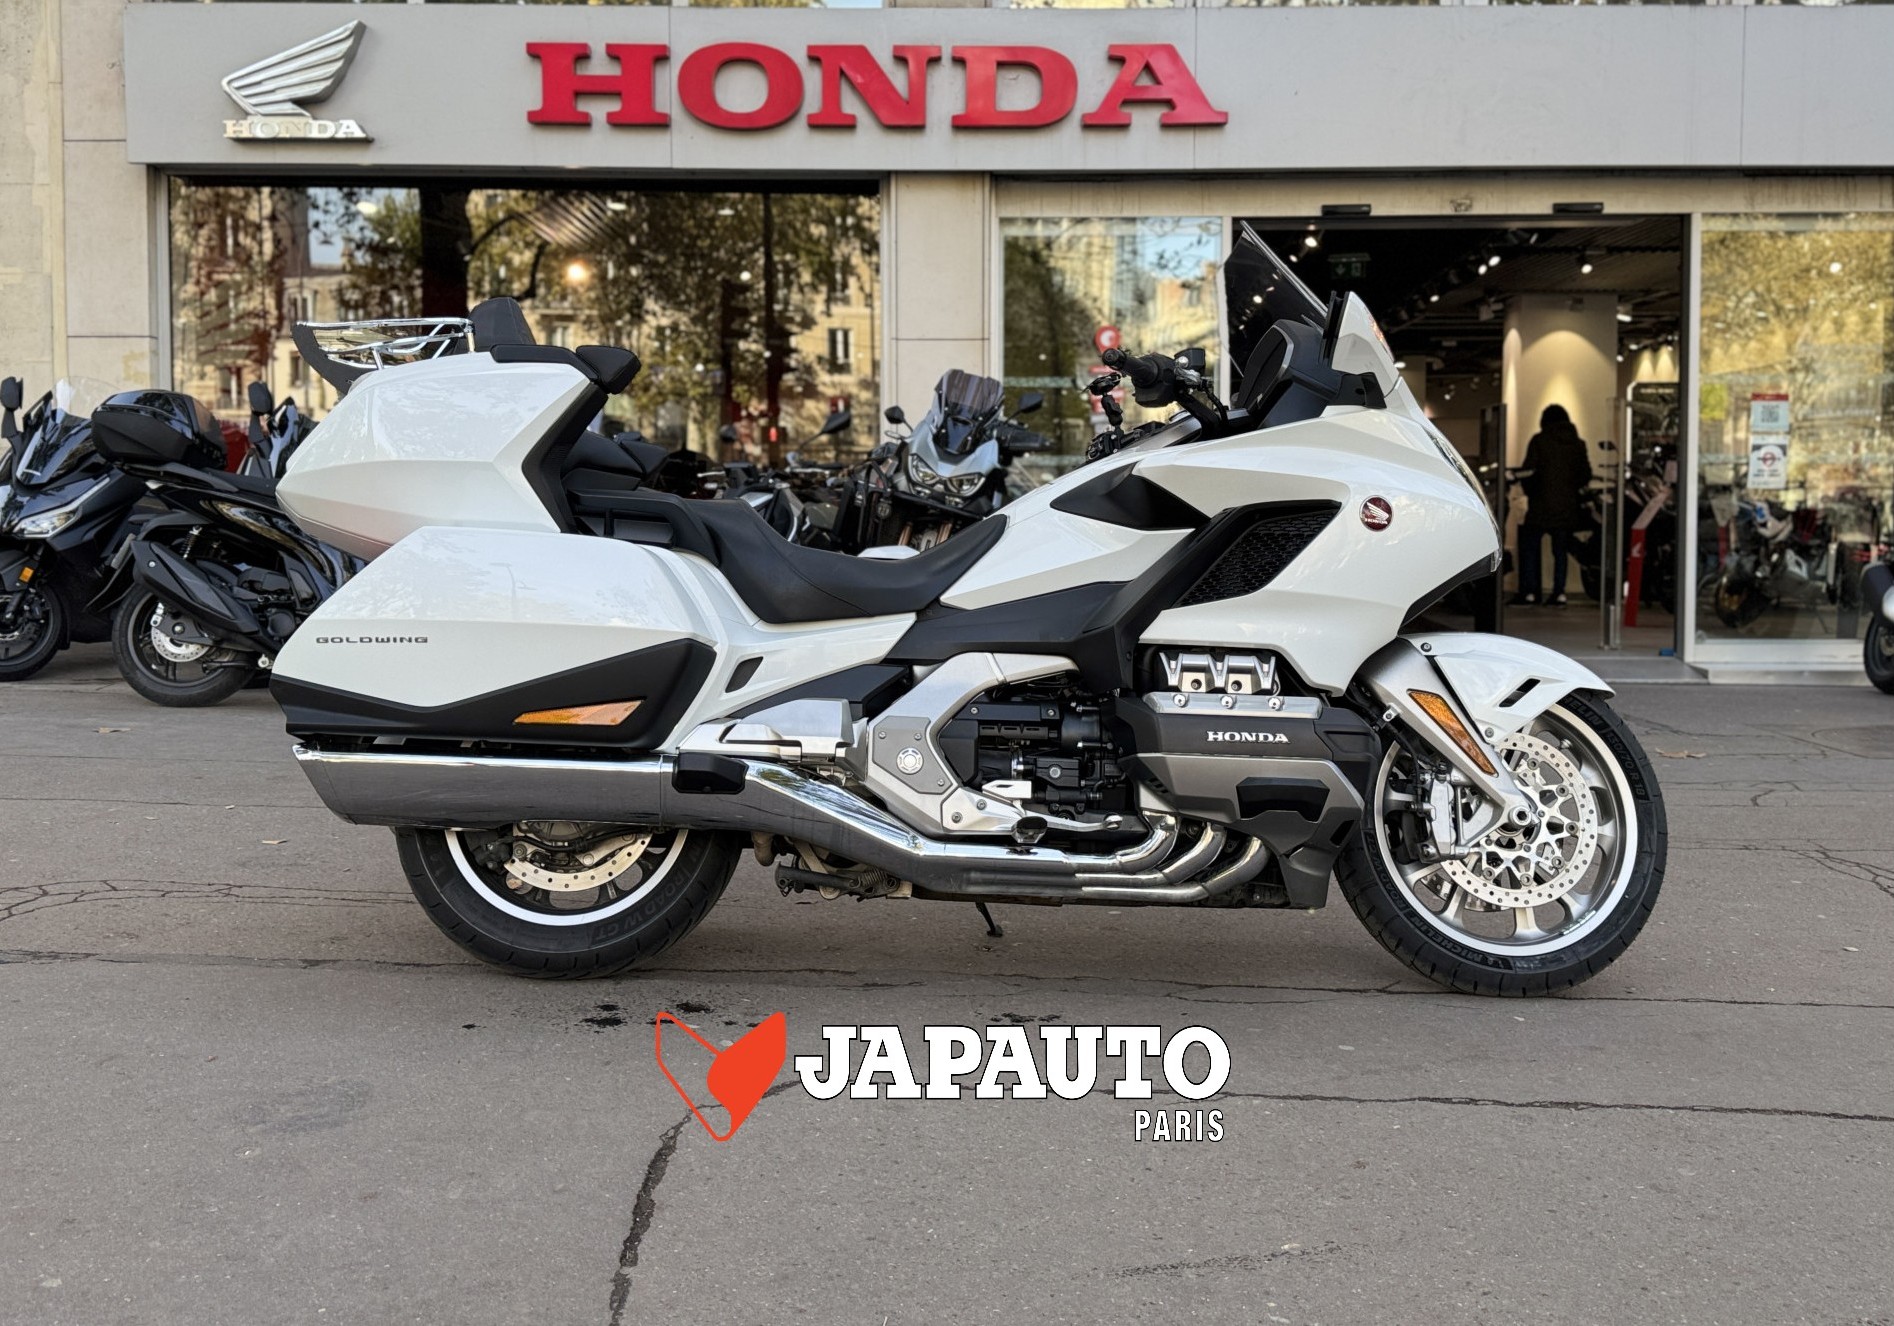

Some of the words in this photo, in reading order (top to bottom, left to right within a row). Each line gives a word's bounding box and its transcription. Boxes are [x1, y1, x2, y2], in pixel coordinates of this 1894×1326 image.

[526, 42, 1229, 129] HONDA
[223, 119, 368, 139] HONDA
[316, 636, 428, 644] GOLDWING
[1206, 731, 1291, 744] HONDA
[1409, 915, 1483, 963] MICHELIN
